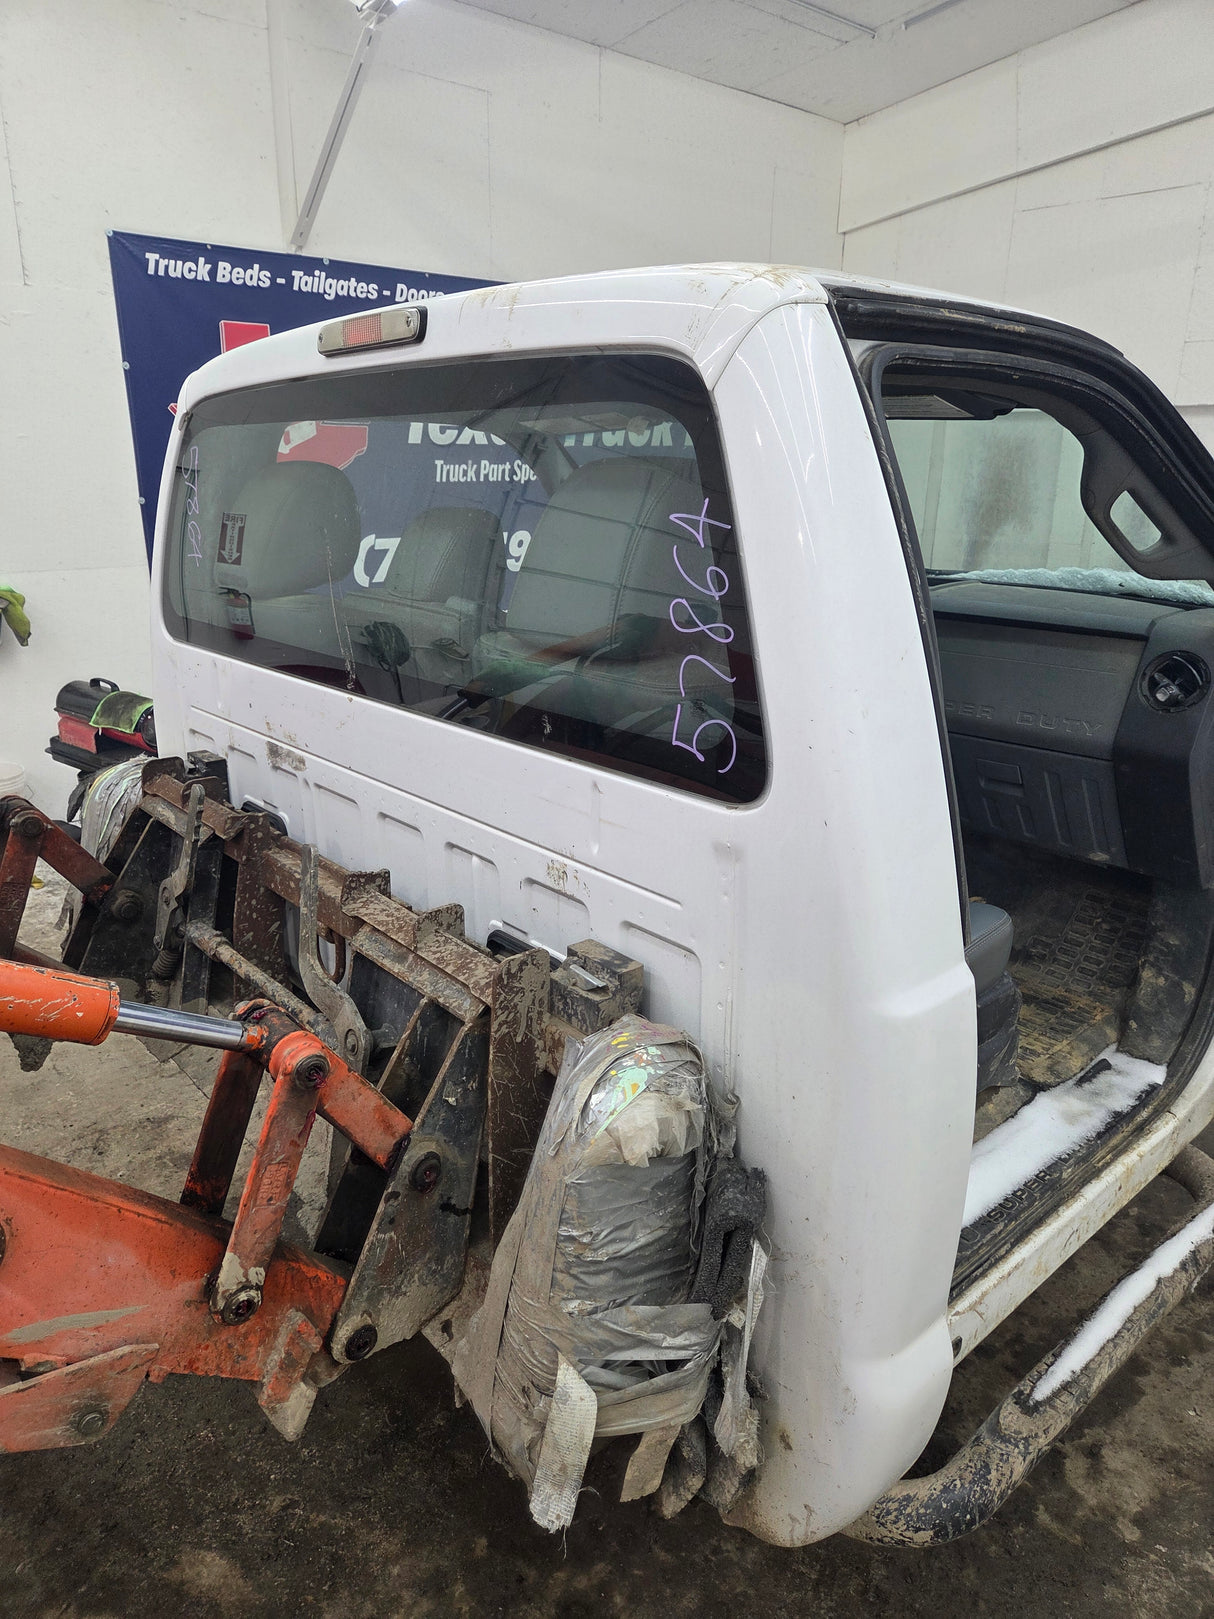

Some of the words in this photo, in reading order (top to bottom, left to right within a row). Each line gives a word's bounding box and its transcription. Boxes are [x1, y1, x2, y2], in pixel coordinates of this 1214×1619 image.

[145, 252, 212, 281] Truck
[216, 261, 271, 288] Beds
[291, 269, 379, 300] Tailgates
[435, 459, 477, 482] Truck
[480, 459, 511, 482] Part
[668, 497, 737, 774] 57864
[1016, 711, 1102, 736] DUTY
[985, 1169, 1052, 1224] SUPER
